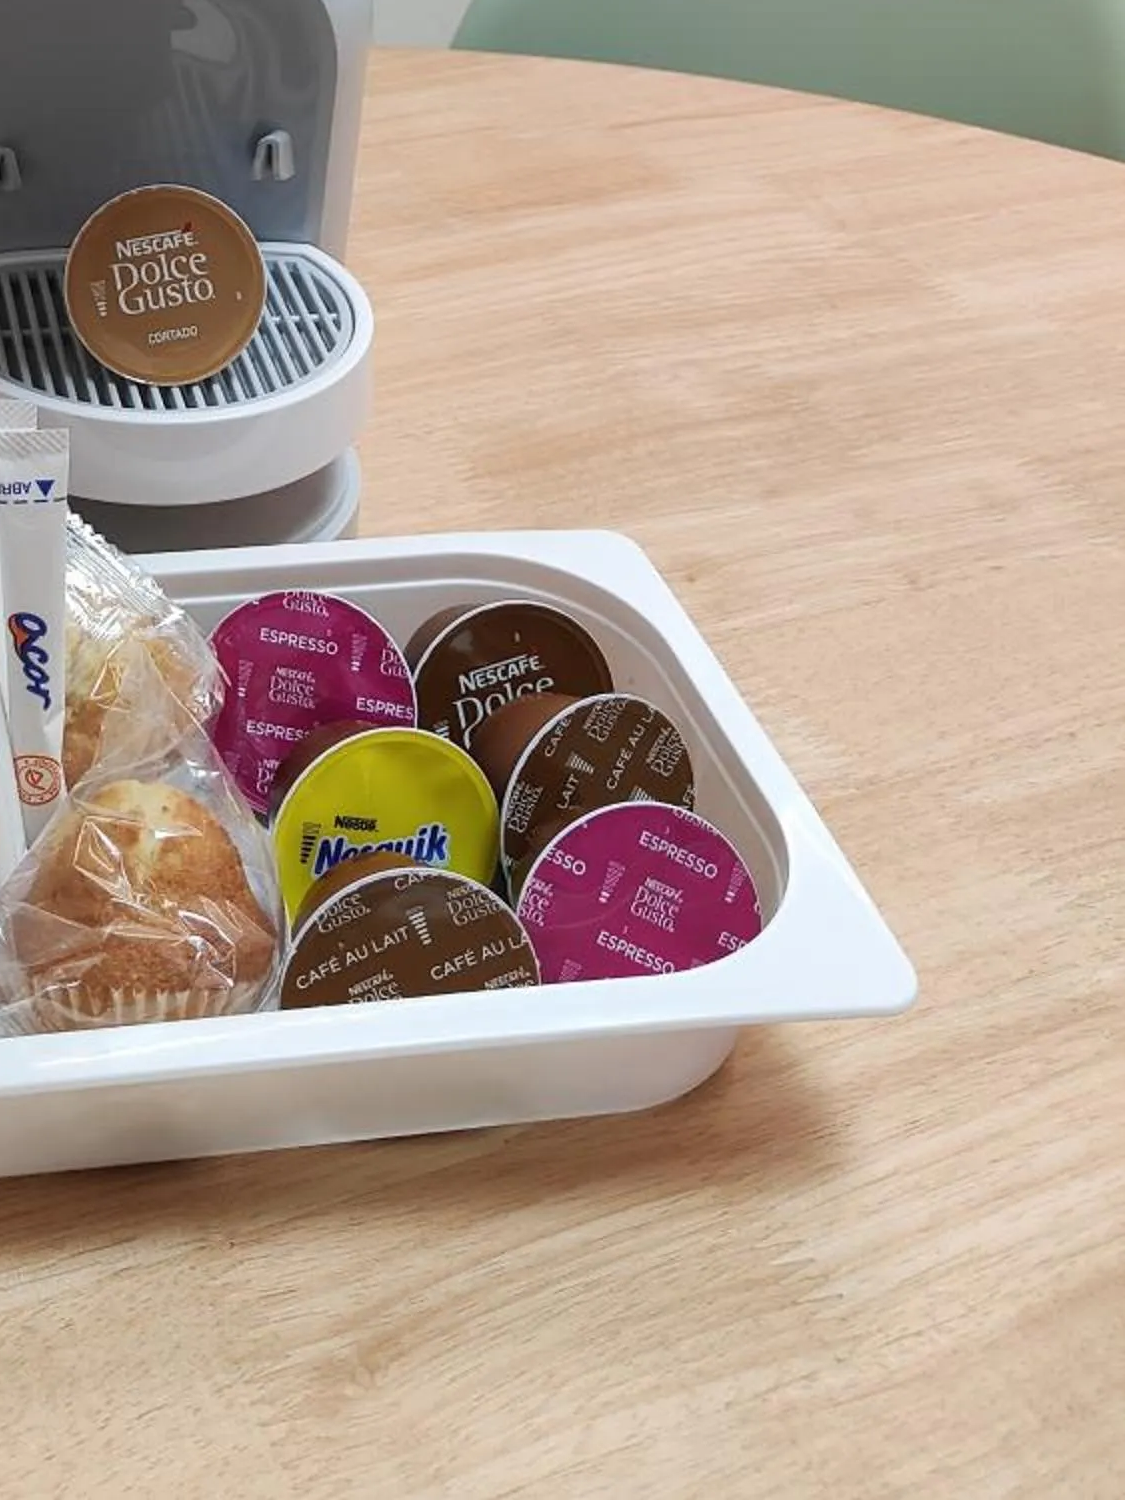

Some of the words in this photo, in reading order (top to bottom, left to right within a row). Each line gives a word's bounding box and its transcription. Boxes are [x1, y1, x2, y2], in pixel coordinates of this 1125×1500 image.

[109, 252, 208, 291] Dolce
[119, 278, 214, 315] Gusto
[148, 325, 198, 344] CORTADO
[259, 627, 338, 655] ESPRESSO
[639, 830, 718, 879] ESPRESSO
[296, 956, 342, 989] CAFÉ
[345, 944, 369, 966] AU
[371, 926, 408, 953] LAIT
[430, 949, 478, 980] CAFÉ
[481, 940, 506, 961] AU
[597, 930, 675, 974] ESPRESSO
